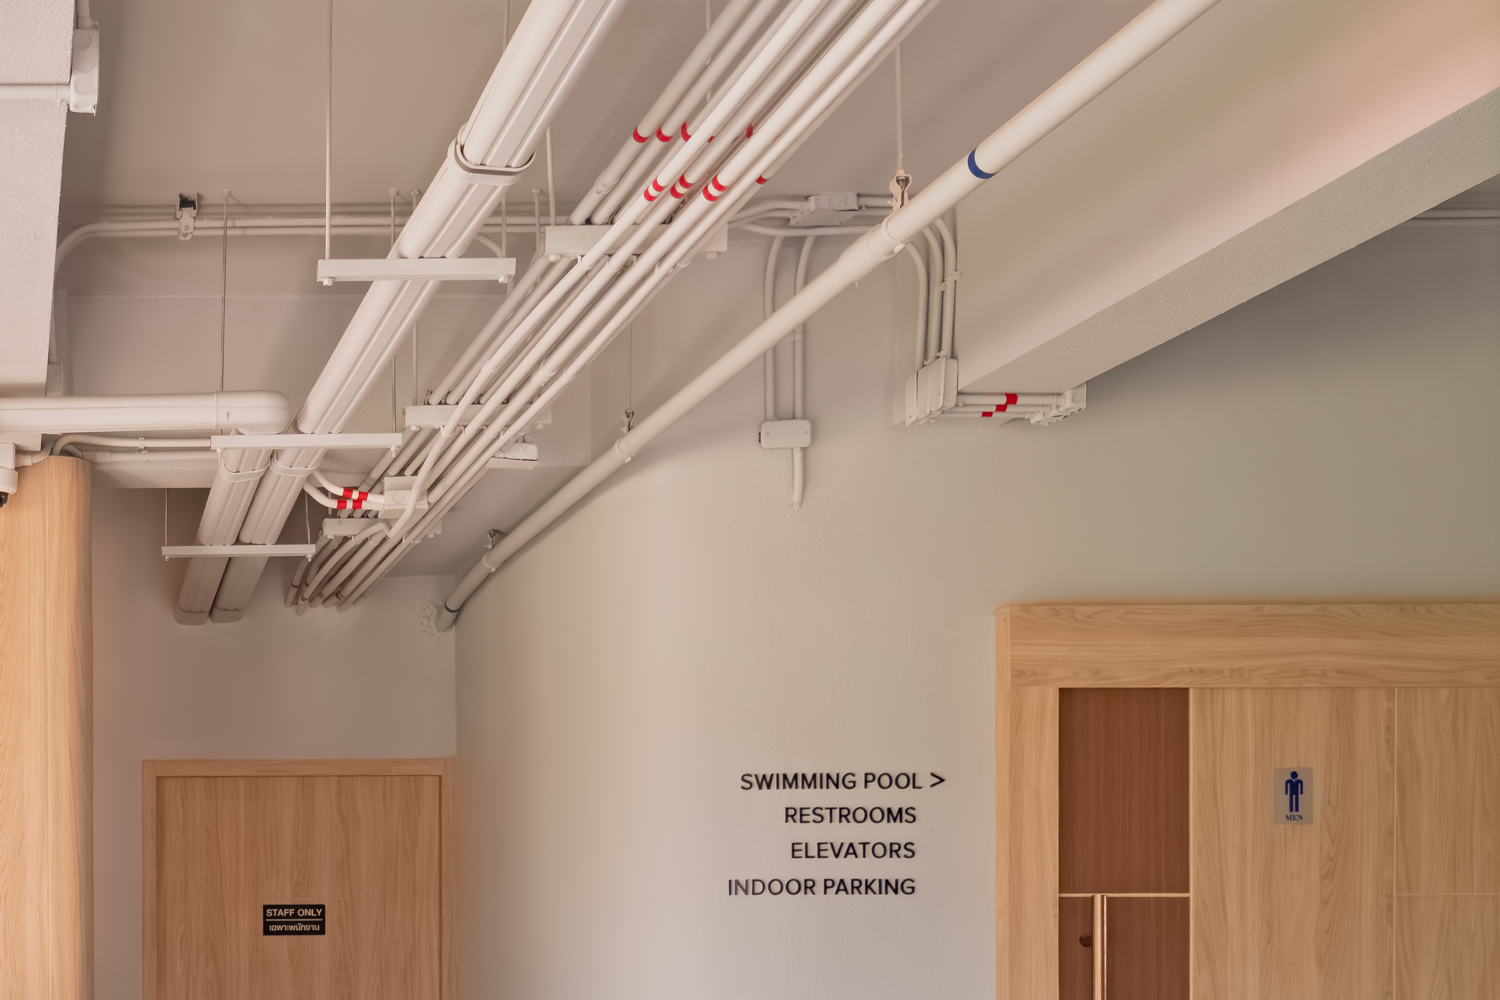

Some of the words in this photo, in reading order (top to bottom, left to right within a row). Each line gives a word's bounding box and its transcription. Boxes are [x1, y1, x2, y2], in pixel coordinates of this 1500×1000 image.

[740, 772, 857, 791] SWIMMING
[863, 772, 923, 790] POOL
[784, 806, 917, 824] RESTROOMS
[791, 842, 916, 859] ELEVATORS
[728, 878, 816, 896] INDOOR
[823, 878, 916, 896] PARKING
[266, 908, 295, 916] STAFF
[297, 908, 322, 916] ONLY
[269, 922, 320, 932] เฉพาะพนักงาน
